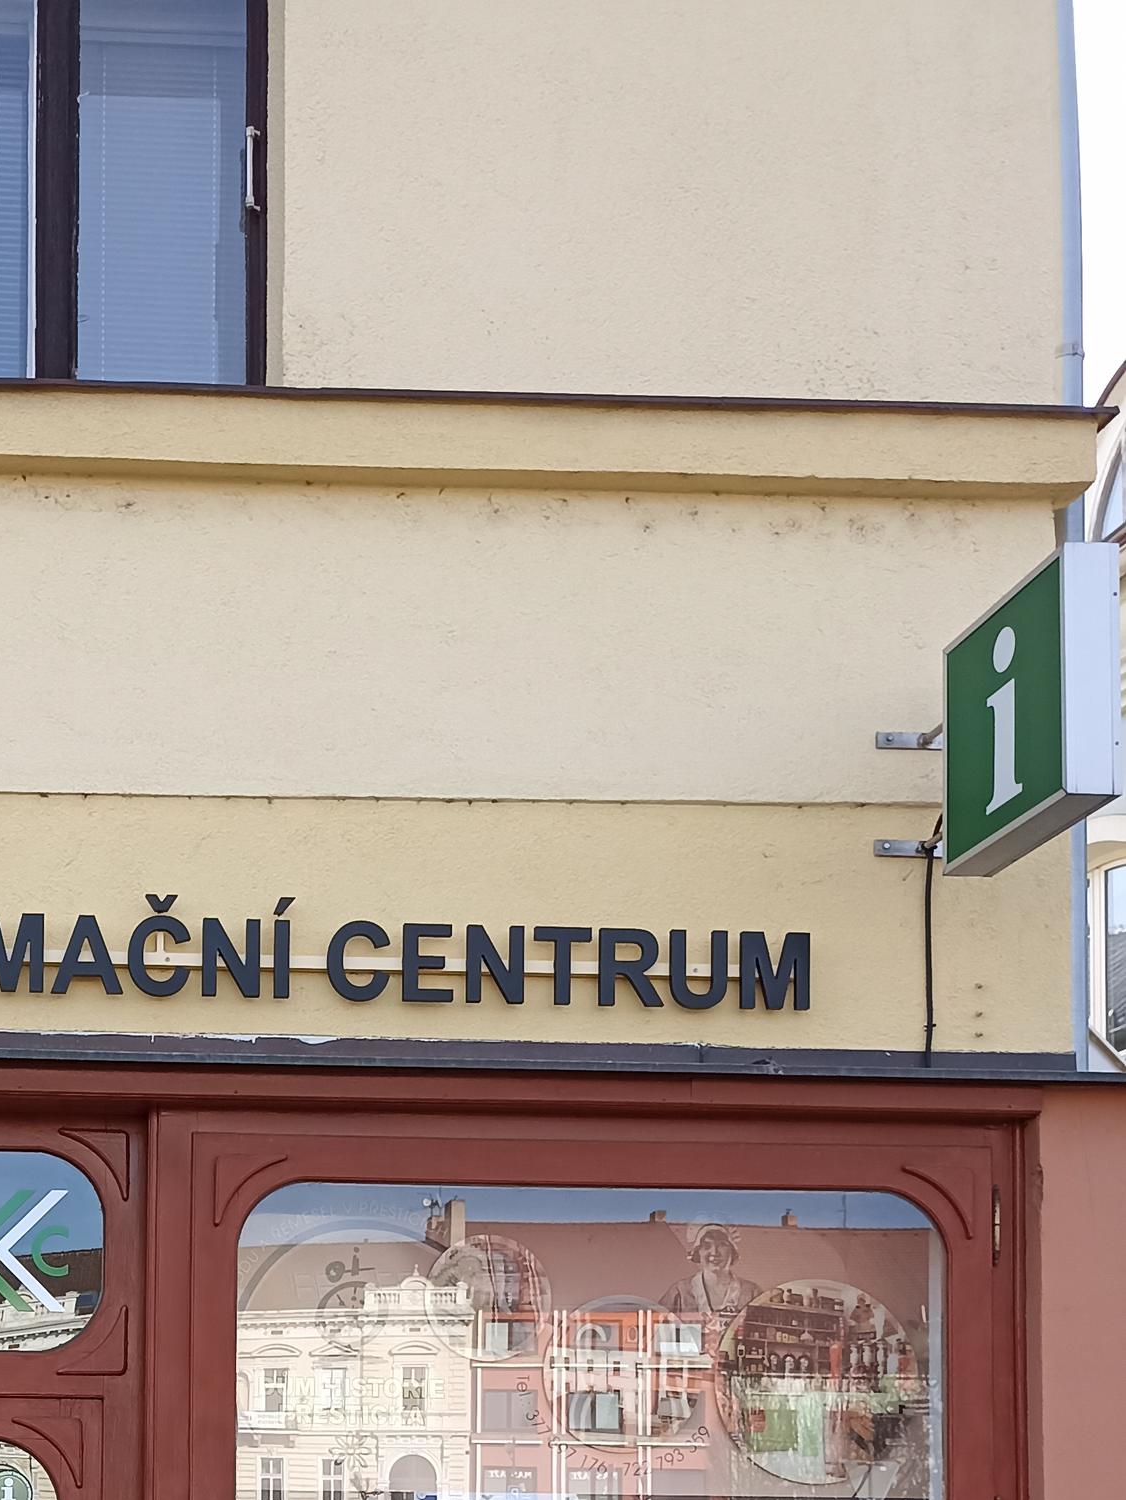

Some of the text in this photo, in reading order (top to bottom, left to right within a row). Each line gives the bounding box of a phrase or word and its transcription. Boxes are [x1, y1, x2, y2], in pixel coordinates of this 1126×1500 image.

[326, 919, 812, 1011] CENTRUM
[526, 1409, 553, 1435] 377
[580, 1454, 607, 1474] 176
[623, 1460, 648, 1476] 722
[656, 1448, 685, 1470] 793
